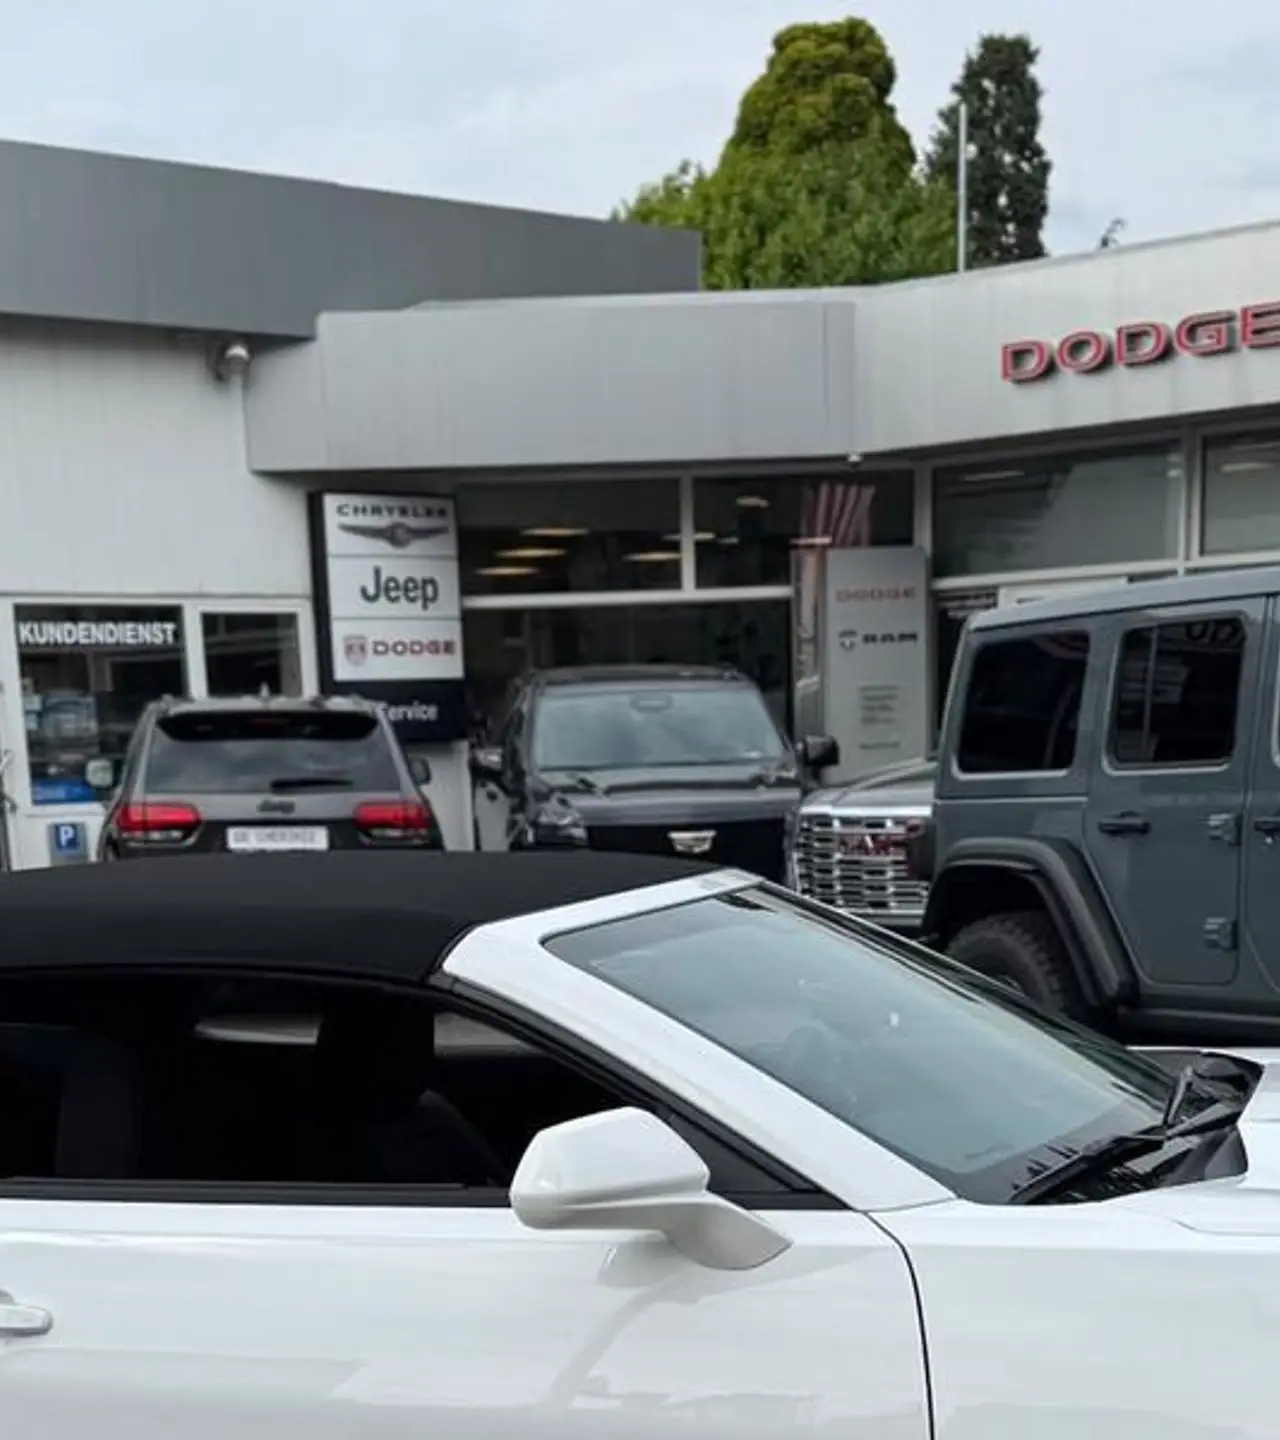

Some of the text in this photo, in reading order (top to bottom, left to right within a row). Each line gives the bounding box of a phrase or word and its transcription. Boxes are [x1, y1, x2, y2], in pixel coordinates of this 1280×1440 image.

[360, 565, 439, 611] Jeep
[19, 622, 177, 645] KUNDENDIENST
[862, 631, 919, 644] RAM
[373, 640, 457, 657] DODGE
[60, 825, 73, 846] P
